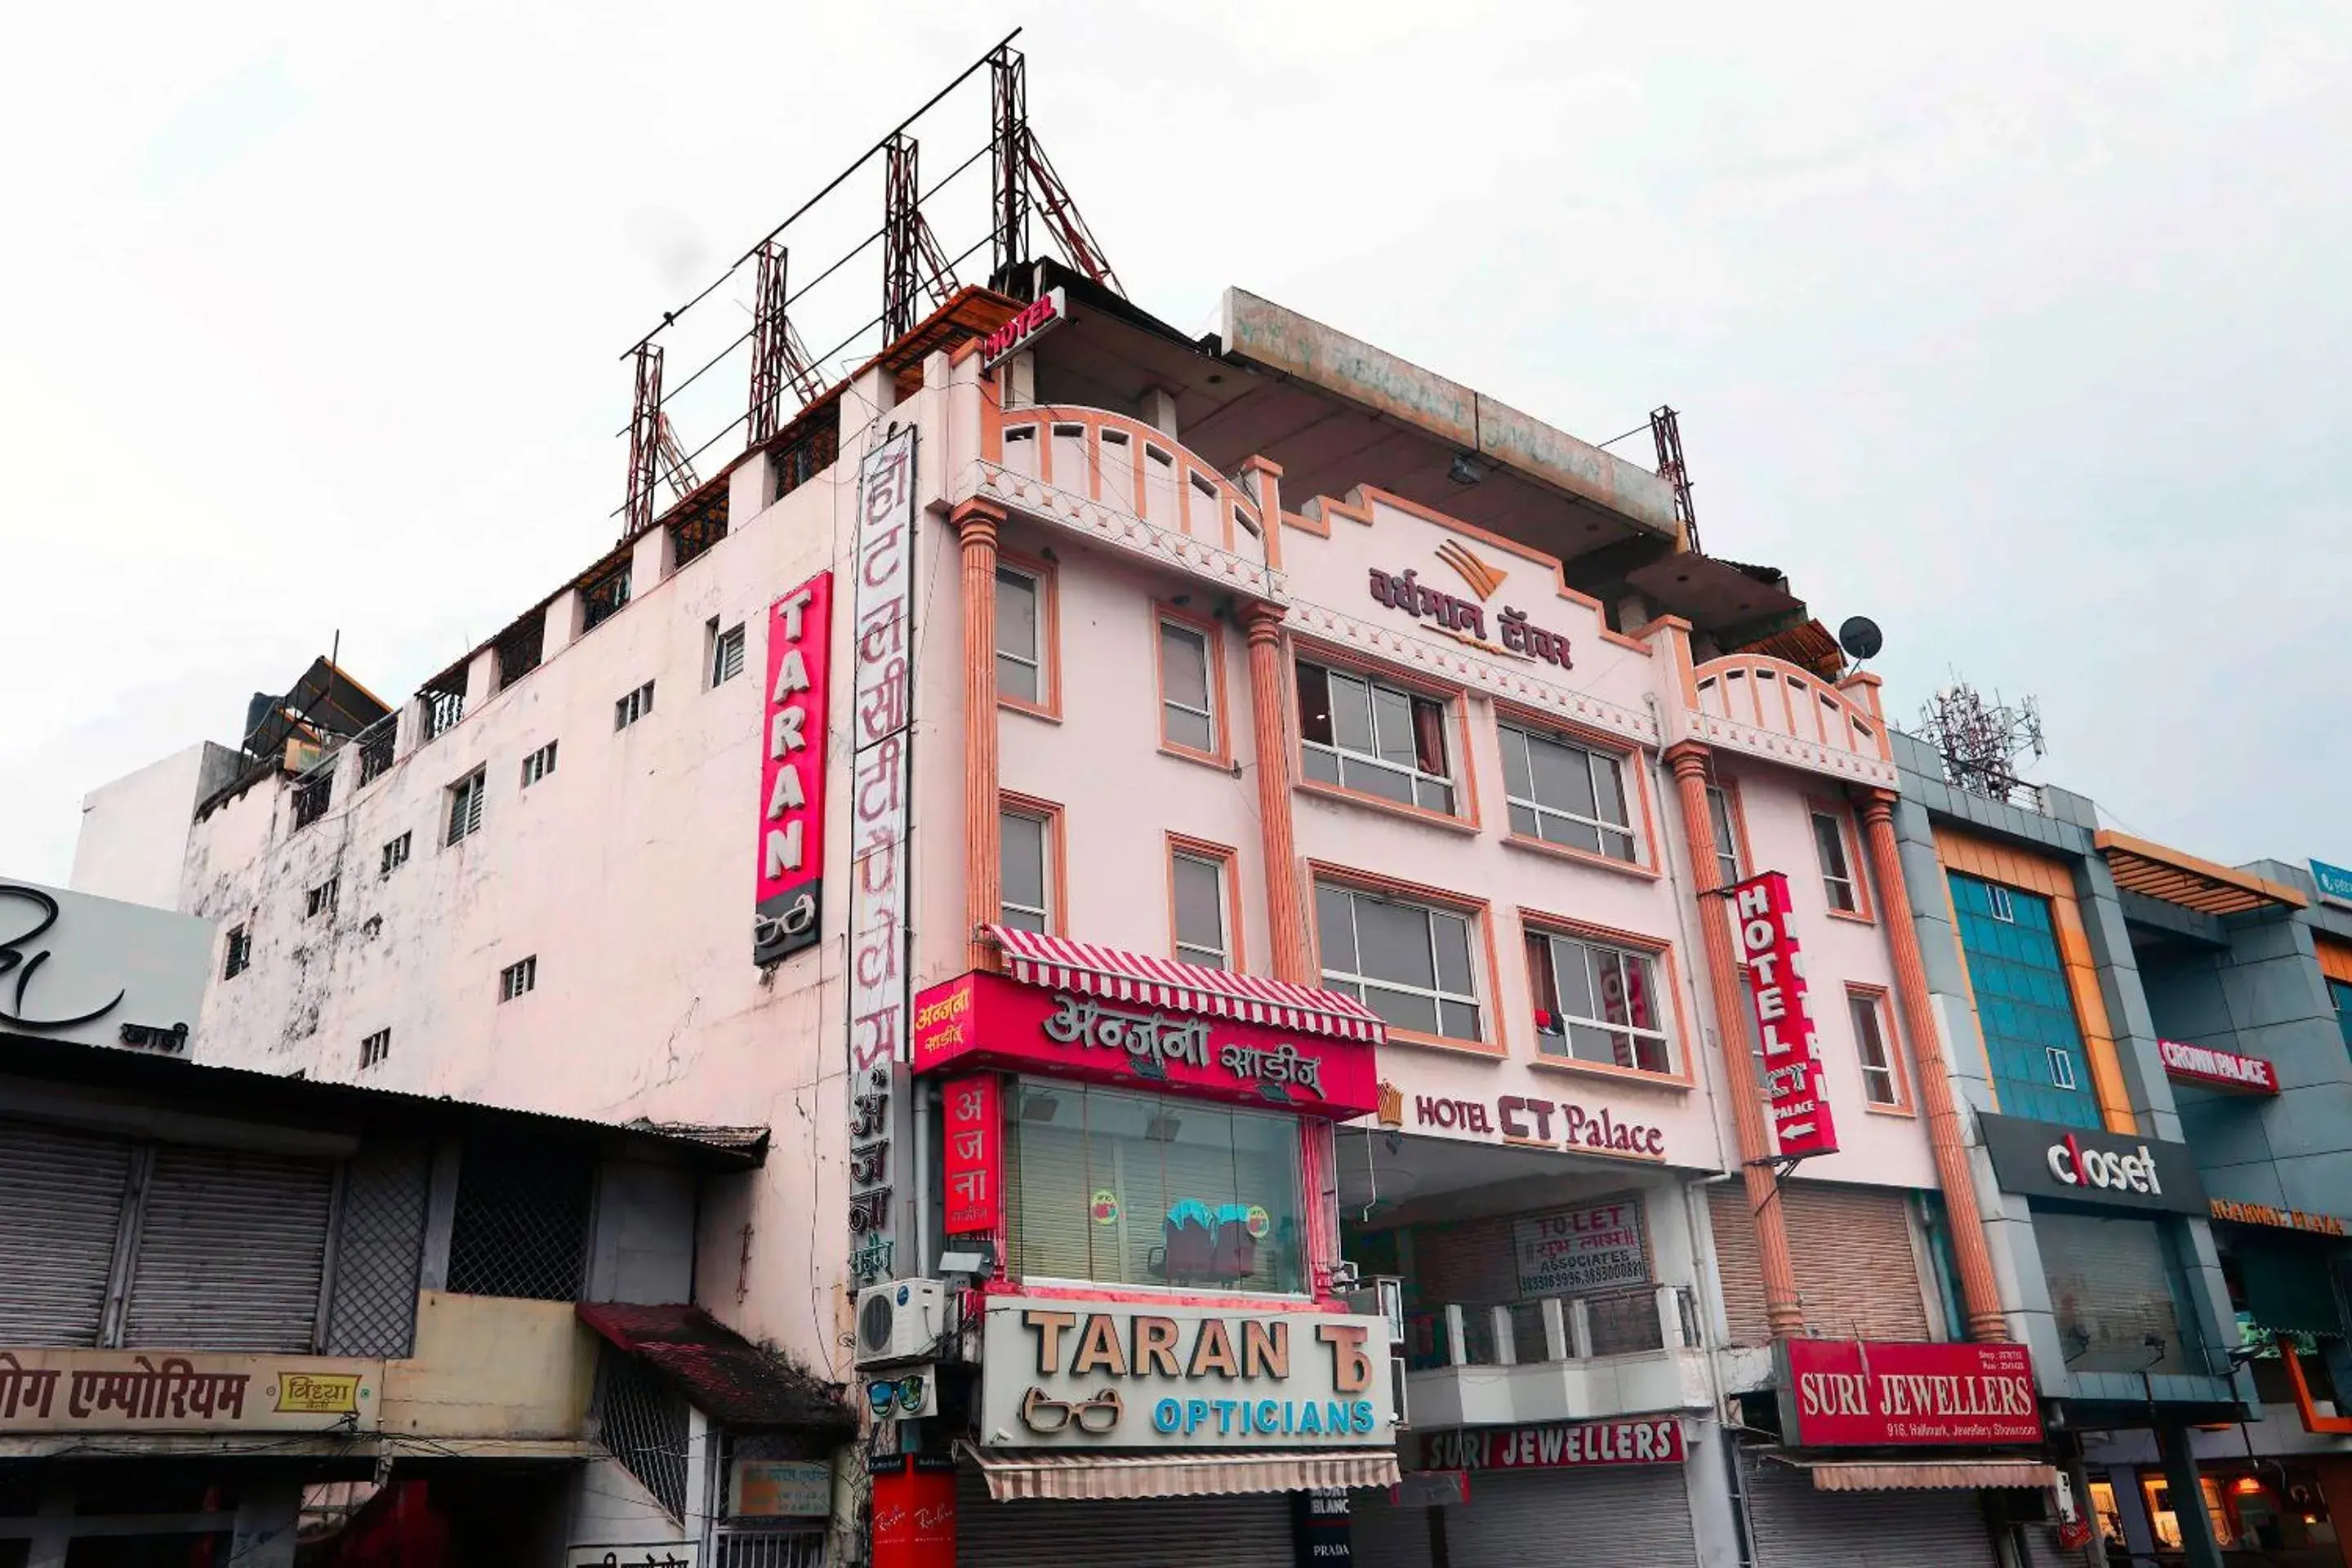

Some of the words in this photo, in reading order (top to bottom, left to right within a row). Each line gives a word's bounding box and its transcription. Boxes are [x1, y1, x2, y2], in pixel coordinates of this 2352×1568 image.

[986, 294, 1058, 361] HOTEL
[765, 587, 812, 881] TARAN
[1738, 885, 1792, 1056] HOTEL
[2214, 1052, 2270, 1085] PALACE
[1415, 1095, 1494, 1134] HOTEL
[1499, 1095, 1556, 1141] CT
[1561, 1103, 1665, 1156] Palace
[1774, 1099, 1815, 1119] PALACE
[2047, 1132, 2163, 1196] closet
[1022, 1310, 1290, 1379] TARAN
[69, 1356, 251, 1420] एम्पोरियम
[1801, 1372, 1870, 1416] SURI
[1878, 1374, 2033, 1416] JEWELLERS
[1153, 1397, 1376, 1436] OPTICIANS
[1430, 1431, 1492, 1469] SURI
[1502, 1420, 1671, 1466] JEWELLERS
[1312, 1498, 1350, 1514] BLANC
[1313, 1544, 1349, 1557] PRADA
